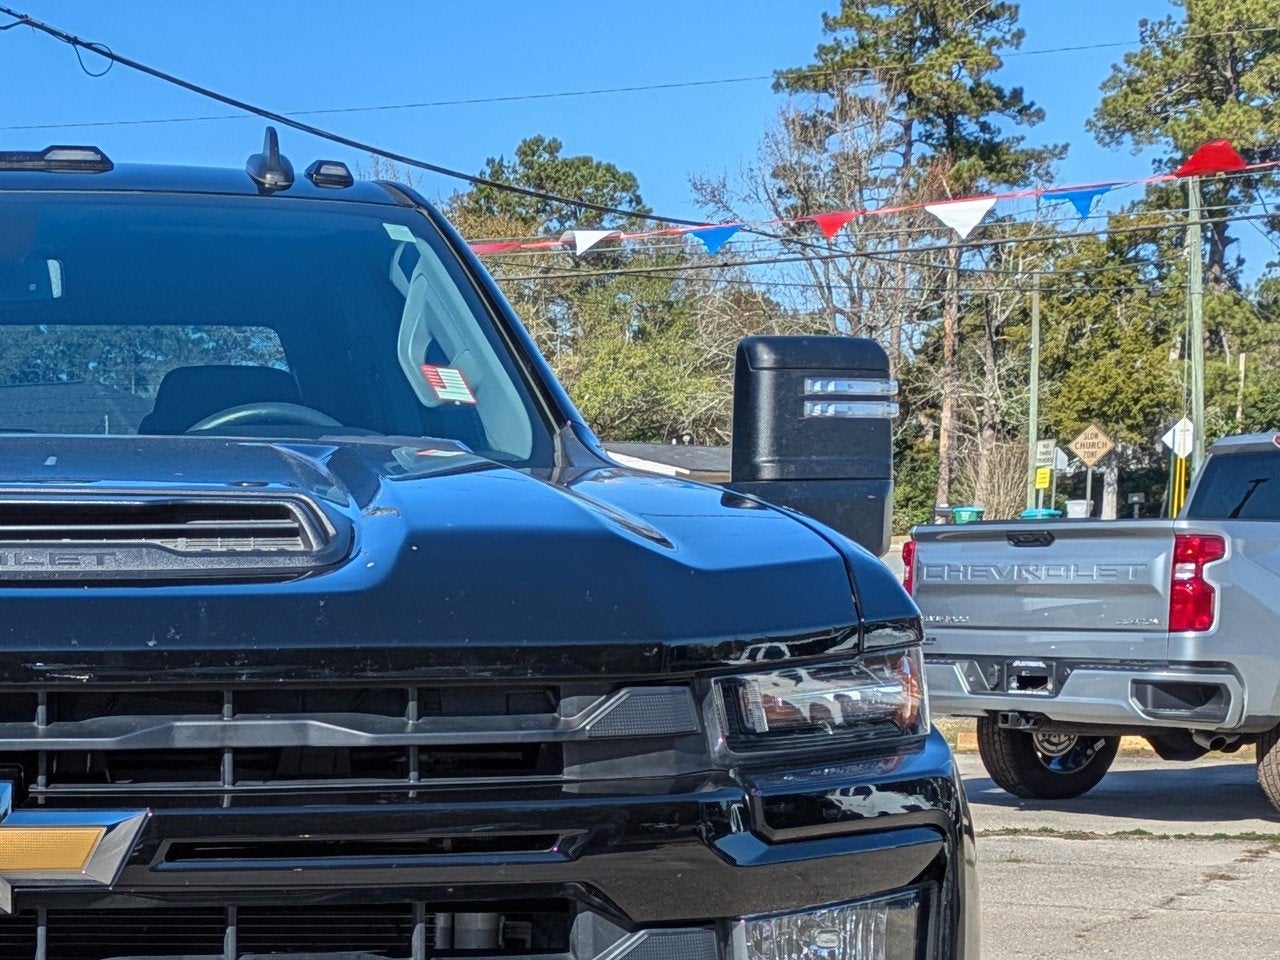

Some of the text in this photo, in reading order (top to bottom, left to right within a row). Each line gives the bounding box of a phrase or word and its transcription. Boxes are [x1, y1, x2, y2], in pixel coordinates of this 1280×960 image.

[1083, 432, 1099, 440] SLOW
[1074, 441, 1108, 450] CHURCH
[1082, 450, 1098, 459] ZONE
[922, 563, 1148, 581] CHEVROLET
